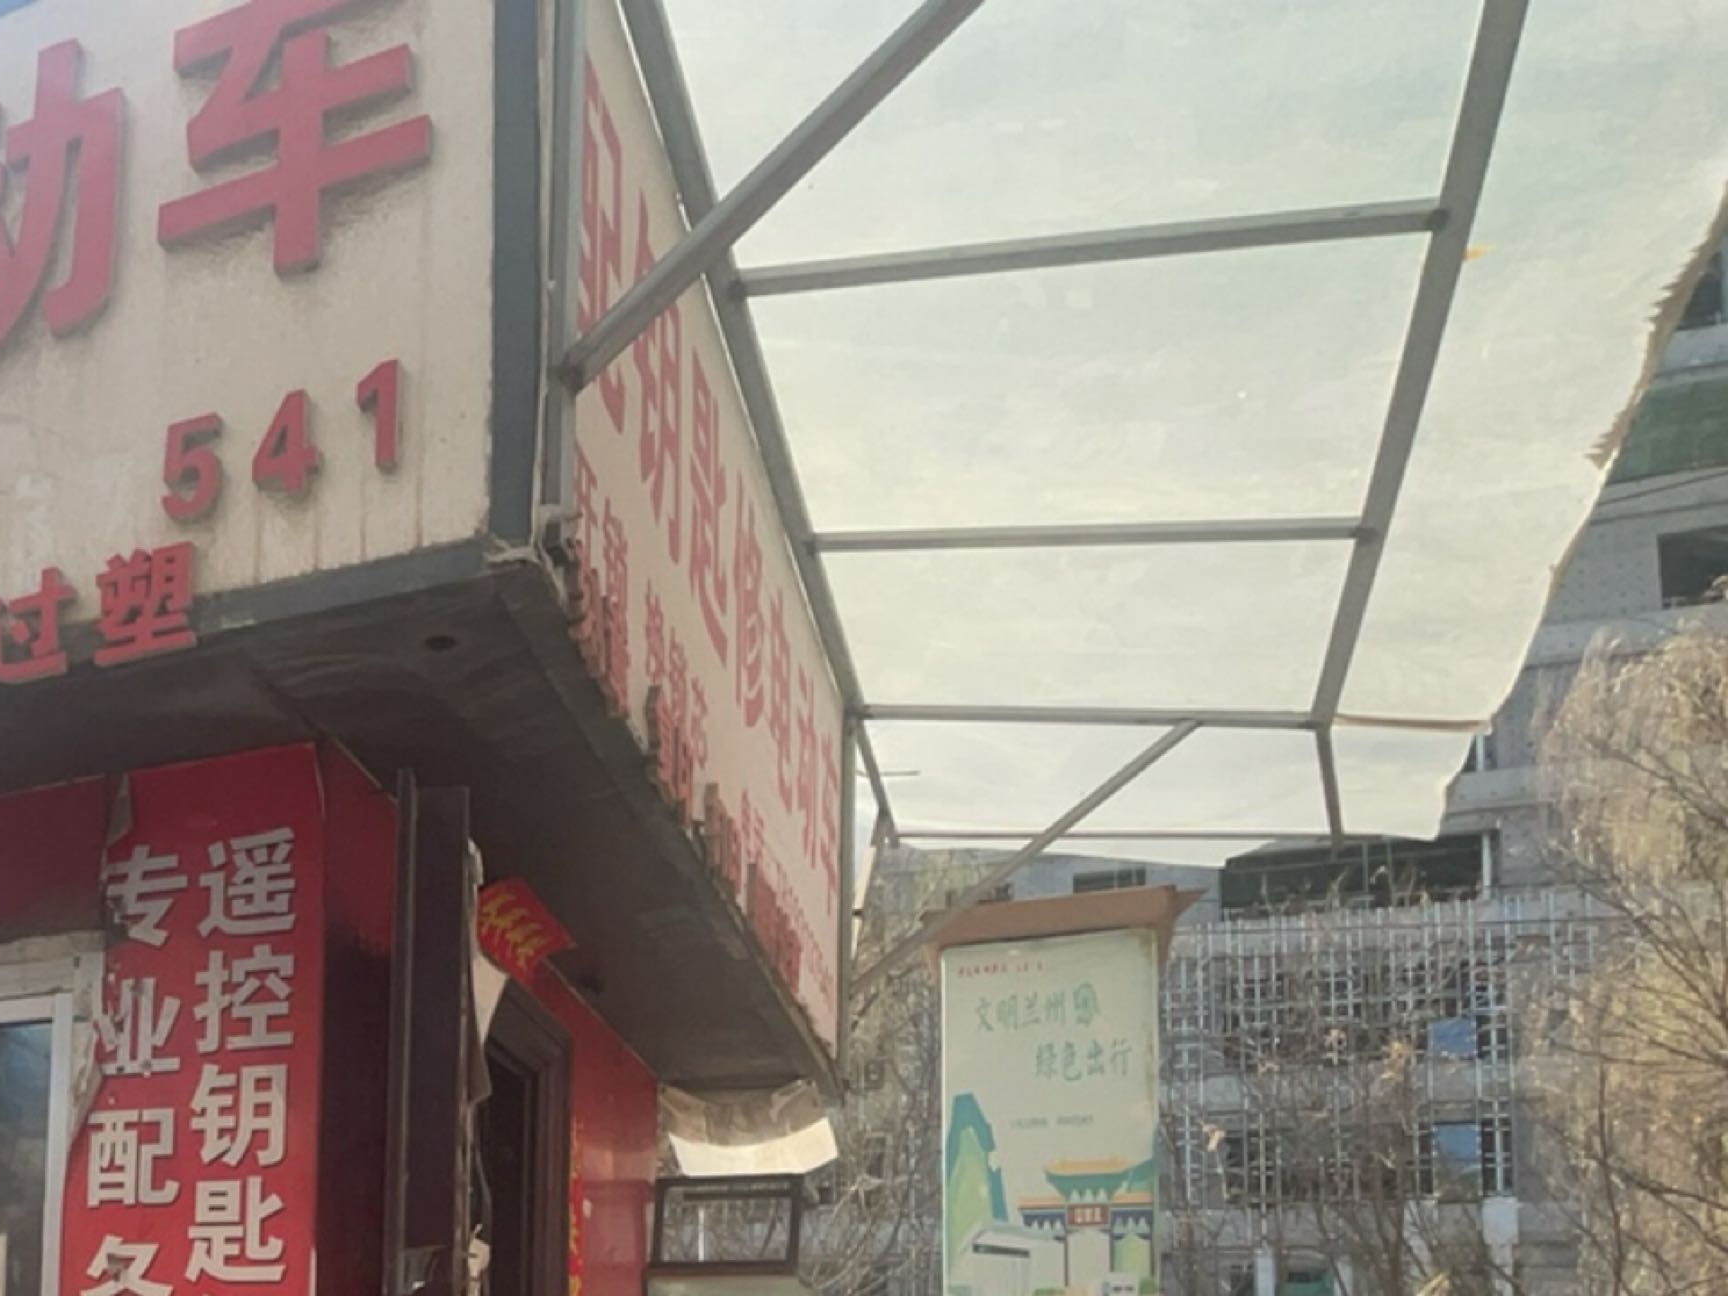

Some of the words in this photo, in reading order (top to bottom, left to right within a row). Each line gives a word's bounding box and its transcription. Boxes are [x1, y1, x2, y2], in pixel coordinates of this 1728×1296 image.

[162, 360, 400, 523] 541
[1034, 1038, 1132, 1080] 绿色出行
